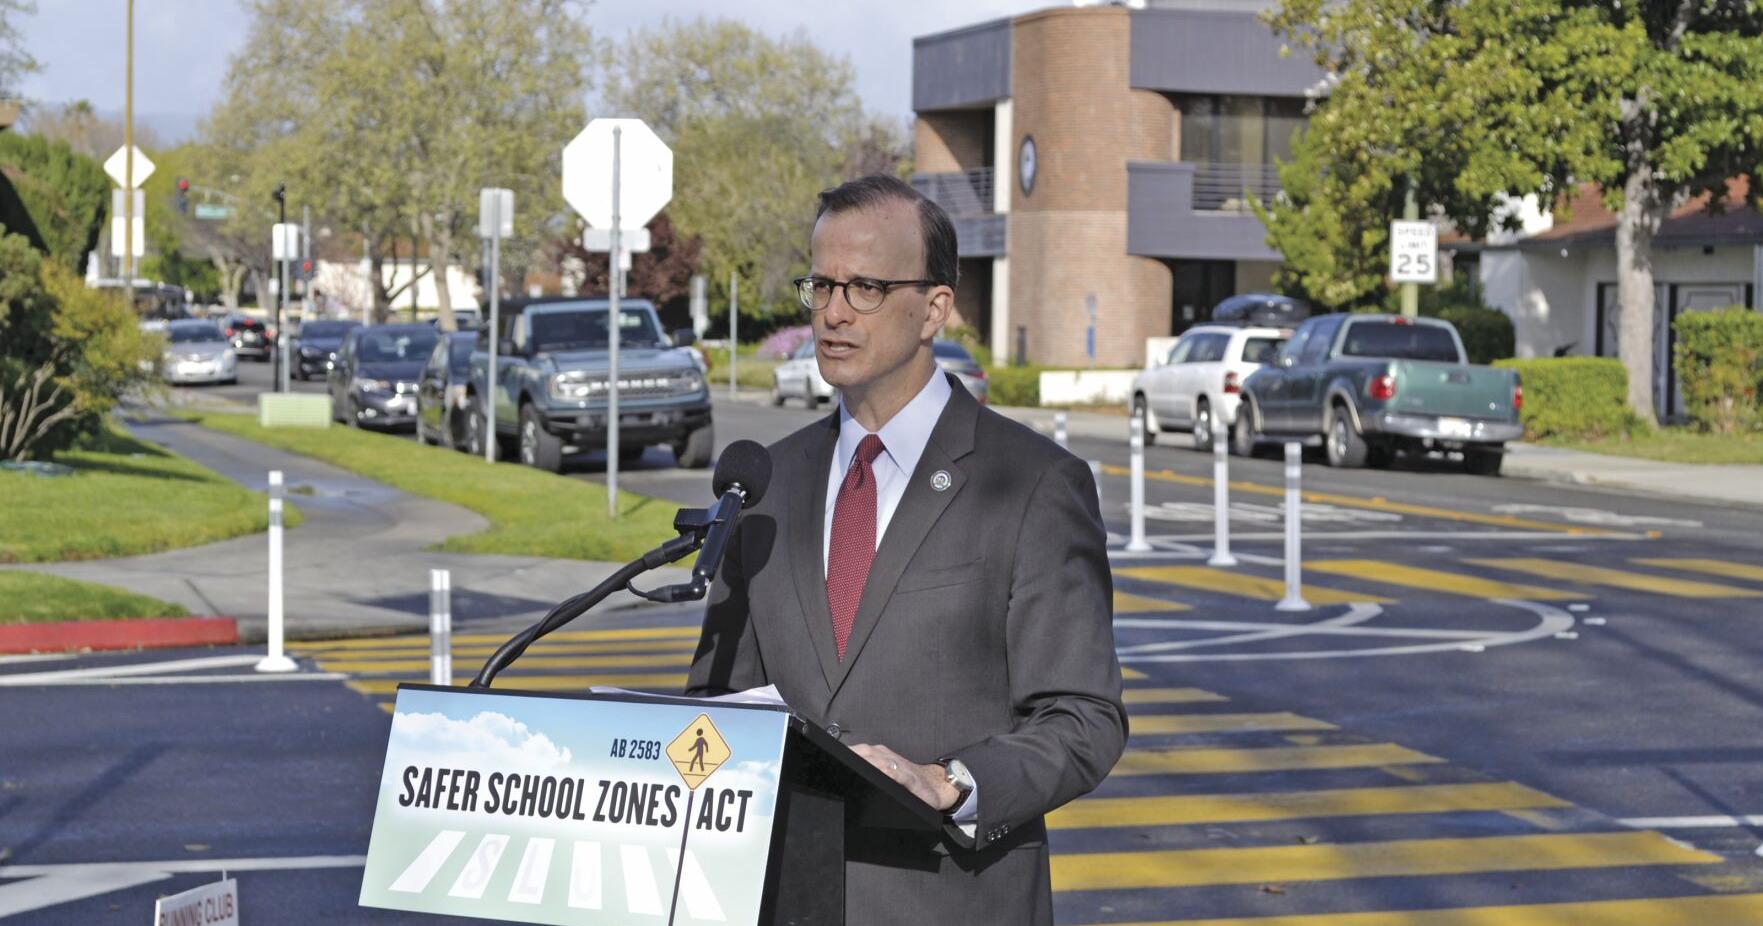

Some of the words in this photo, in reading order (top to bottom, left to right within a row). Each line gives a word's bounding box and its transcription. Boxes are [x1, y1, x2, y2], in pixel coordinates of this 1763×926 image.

[1397, 253, 1431, 275] 25
[610, 738, 627, 759] AB
[629, 740, 662, 760] 2583
[399, 765, 481, 812] SAFER
[484, 772, 585, 820] SCHOOL
[592, 779, 681, 828] ZONES
[696, 788, 753, 832] ACT
[205, 893, 233, 924] CLUB
